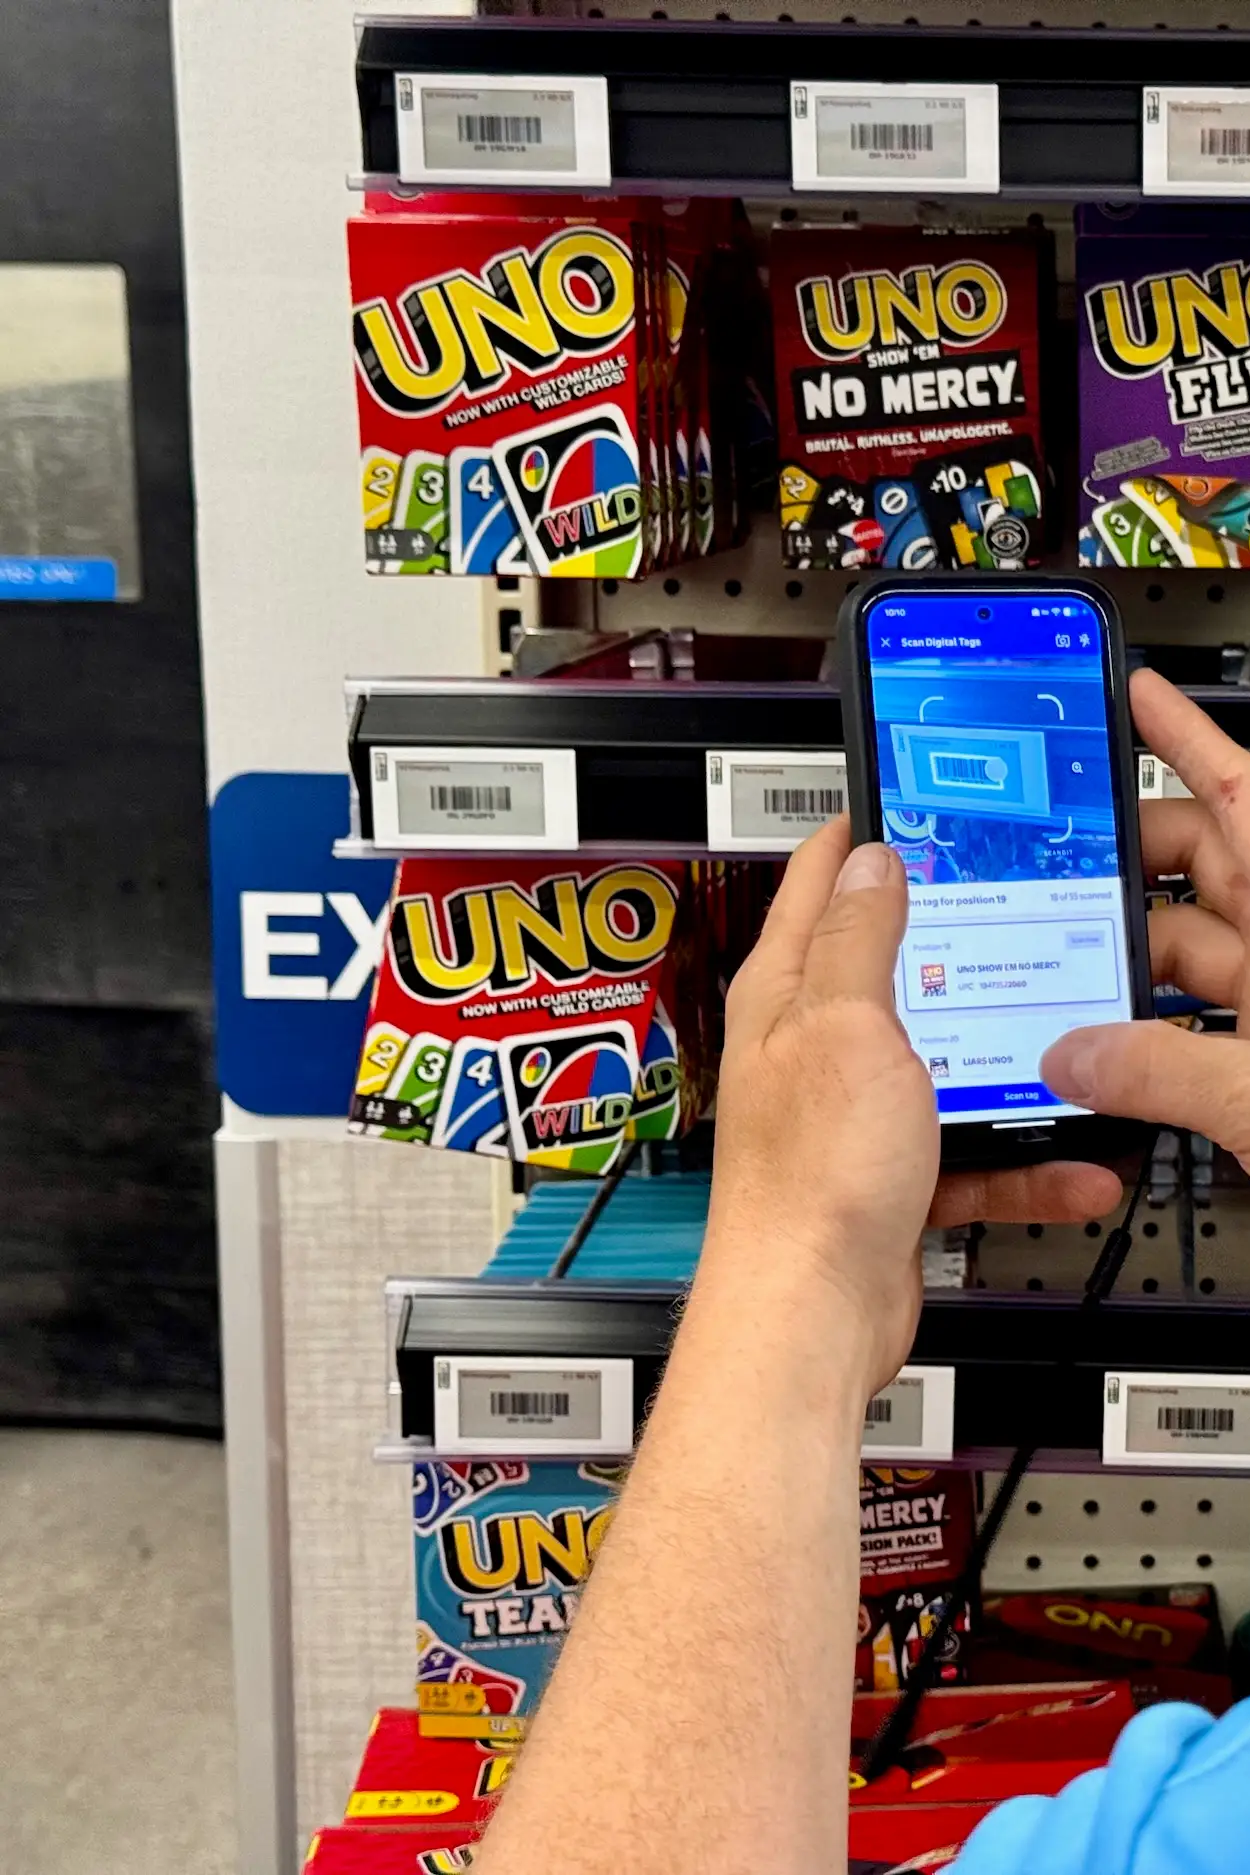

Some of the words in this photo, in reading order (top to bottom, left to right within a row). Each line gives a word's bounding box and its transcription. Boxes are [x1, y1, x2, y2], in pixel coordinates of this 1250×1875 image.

[354, 229, 635, 412] UNO
[797, 260, 1006, 360] UNO
[867, 348, 910, 369] SHOW
[445, 406, 482, 427] NOW
[481, 392, 520, 415] WITH
[520, 354, 629, 402] CUSTOMIZABLE
[533, 388, 572, 411] WILD
[572, 369, 627, 398] CARDS!
[802, 371, 867, 421] NO
[805, 436, 855, 454] BRUTAL.
[857, 429, 918, 450] RUTHLESS.
[920, 421, 1014, 443] UNAPOLOGETIC.
[366, 466, 395, 498] 2
[418, 470, 444, 504] 3
[467, 465, 495, 500] 4
[930, 464, 967, 494] +10
[544, 488, 641, 547] WILD
[1110, 513, 1132, 536] 3
[901, 637, 925, 648] Scan
[925, 637, 957, 649] Digital
[958, 637, 982, 649] Tags
[923, 896, 938, 908] tag
[940, 895, 955, 907] for
[956, 894, 995, 910] position
[392, 865, 677, 1000] UNO
[957, 964, 976, 974] UNO
[977, 963, 1003, 973] SHOW
[1018, 962, 1031, 971] NO
[1032, 961, 1061, 970] MERCY
[462, 1002, 498, 1018] NOW
[501, 996, 538, 1014] WITH
[540, 980, 650, 1008] CUSTOMIZABLE
[551, 1002, 590, 1017] WILD
[592, 992, 646, 1013] CARDS!
[367, 1040, 399, 1068] 2
[417, 1051, 446, 1083] 3
[467, 1055, 494, 1087] 4
[1004, 1091, 1024, 1101] Scan
[532, 1098, 634, 1139] WILD
[897, 1532, 938, 1549] PACK!
[1044, 1603, 1173, 1648] UNO
